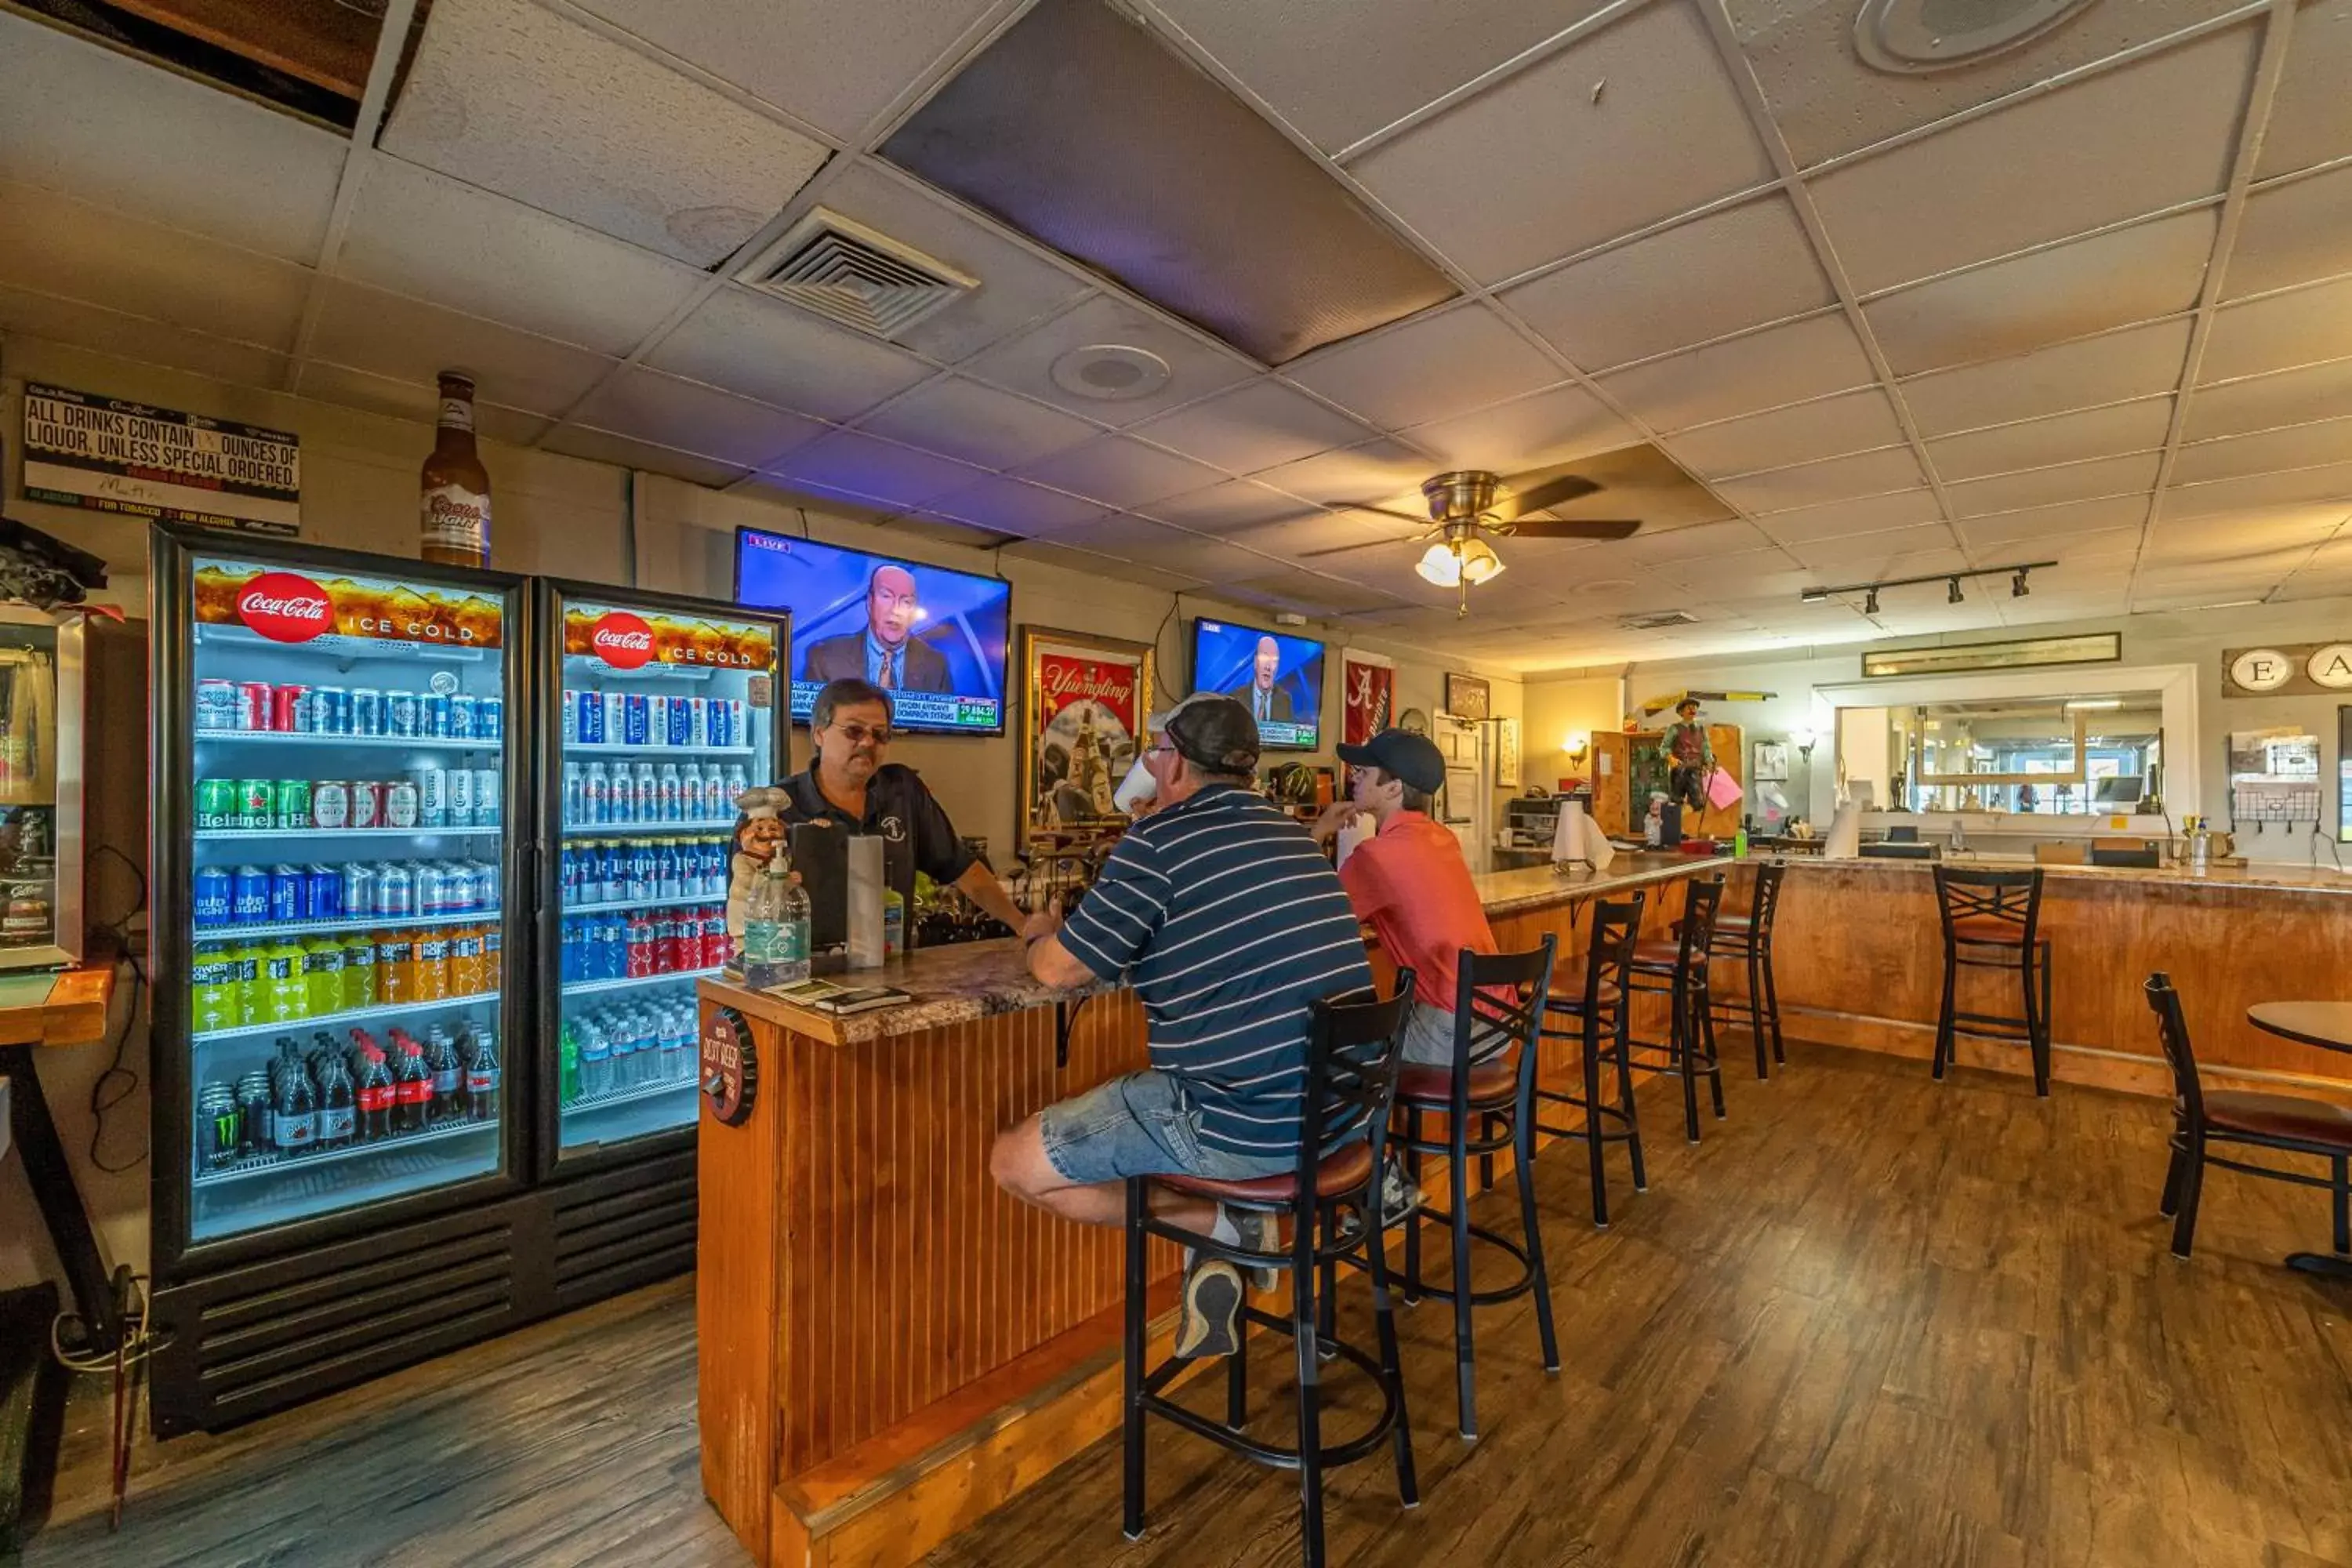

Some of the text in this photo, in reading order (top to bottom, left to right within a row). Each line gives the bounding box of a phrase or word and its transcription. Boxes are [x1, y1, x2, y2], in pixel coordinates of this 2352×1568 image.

[27, 399, 58, 424] ALL
[64, 405, 124, 436] DRINKS
[128, 418, 194, 448] CONTAIN
[222, 435, 276, 463] OUNCES
[280, 446, 297, 466] OF
[98, 434, 159, 463] UNLESS
[162, 445, 224, 474] SPECIAL
[120, 502, 162, 517] TOBACCO
[198, 514, 238, 528] ALCOHOL
[430, 514, 479, 530] LIGHT
[241, 592, 329, 620] Coca-Cola
[349, 617, 474, 641] ICE COLD
[594, 629, 652, 650] Coca-Cola
[705, 651, 751, 665] COLD
[2323, 654, 2352, 677] A
[2250, 661, 2275, 682] E
[1045, 664, 1133, 705] Yuengling
[593, 704, 602, 738] ULTRA
[633, 709, 642, 739] ULTRA
[197, 897, 227, 908] BUD
[193, 962, 228, 974] OWER
